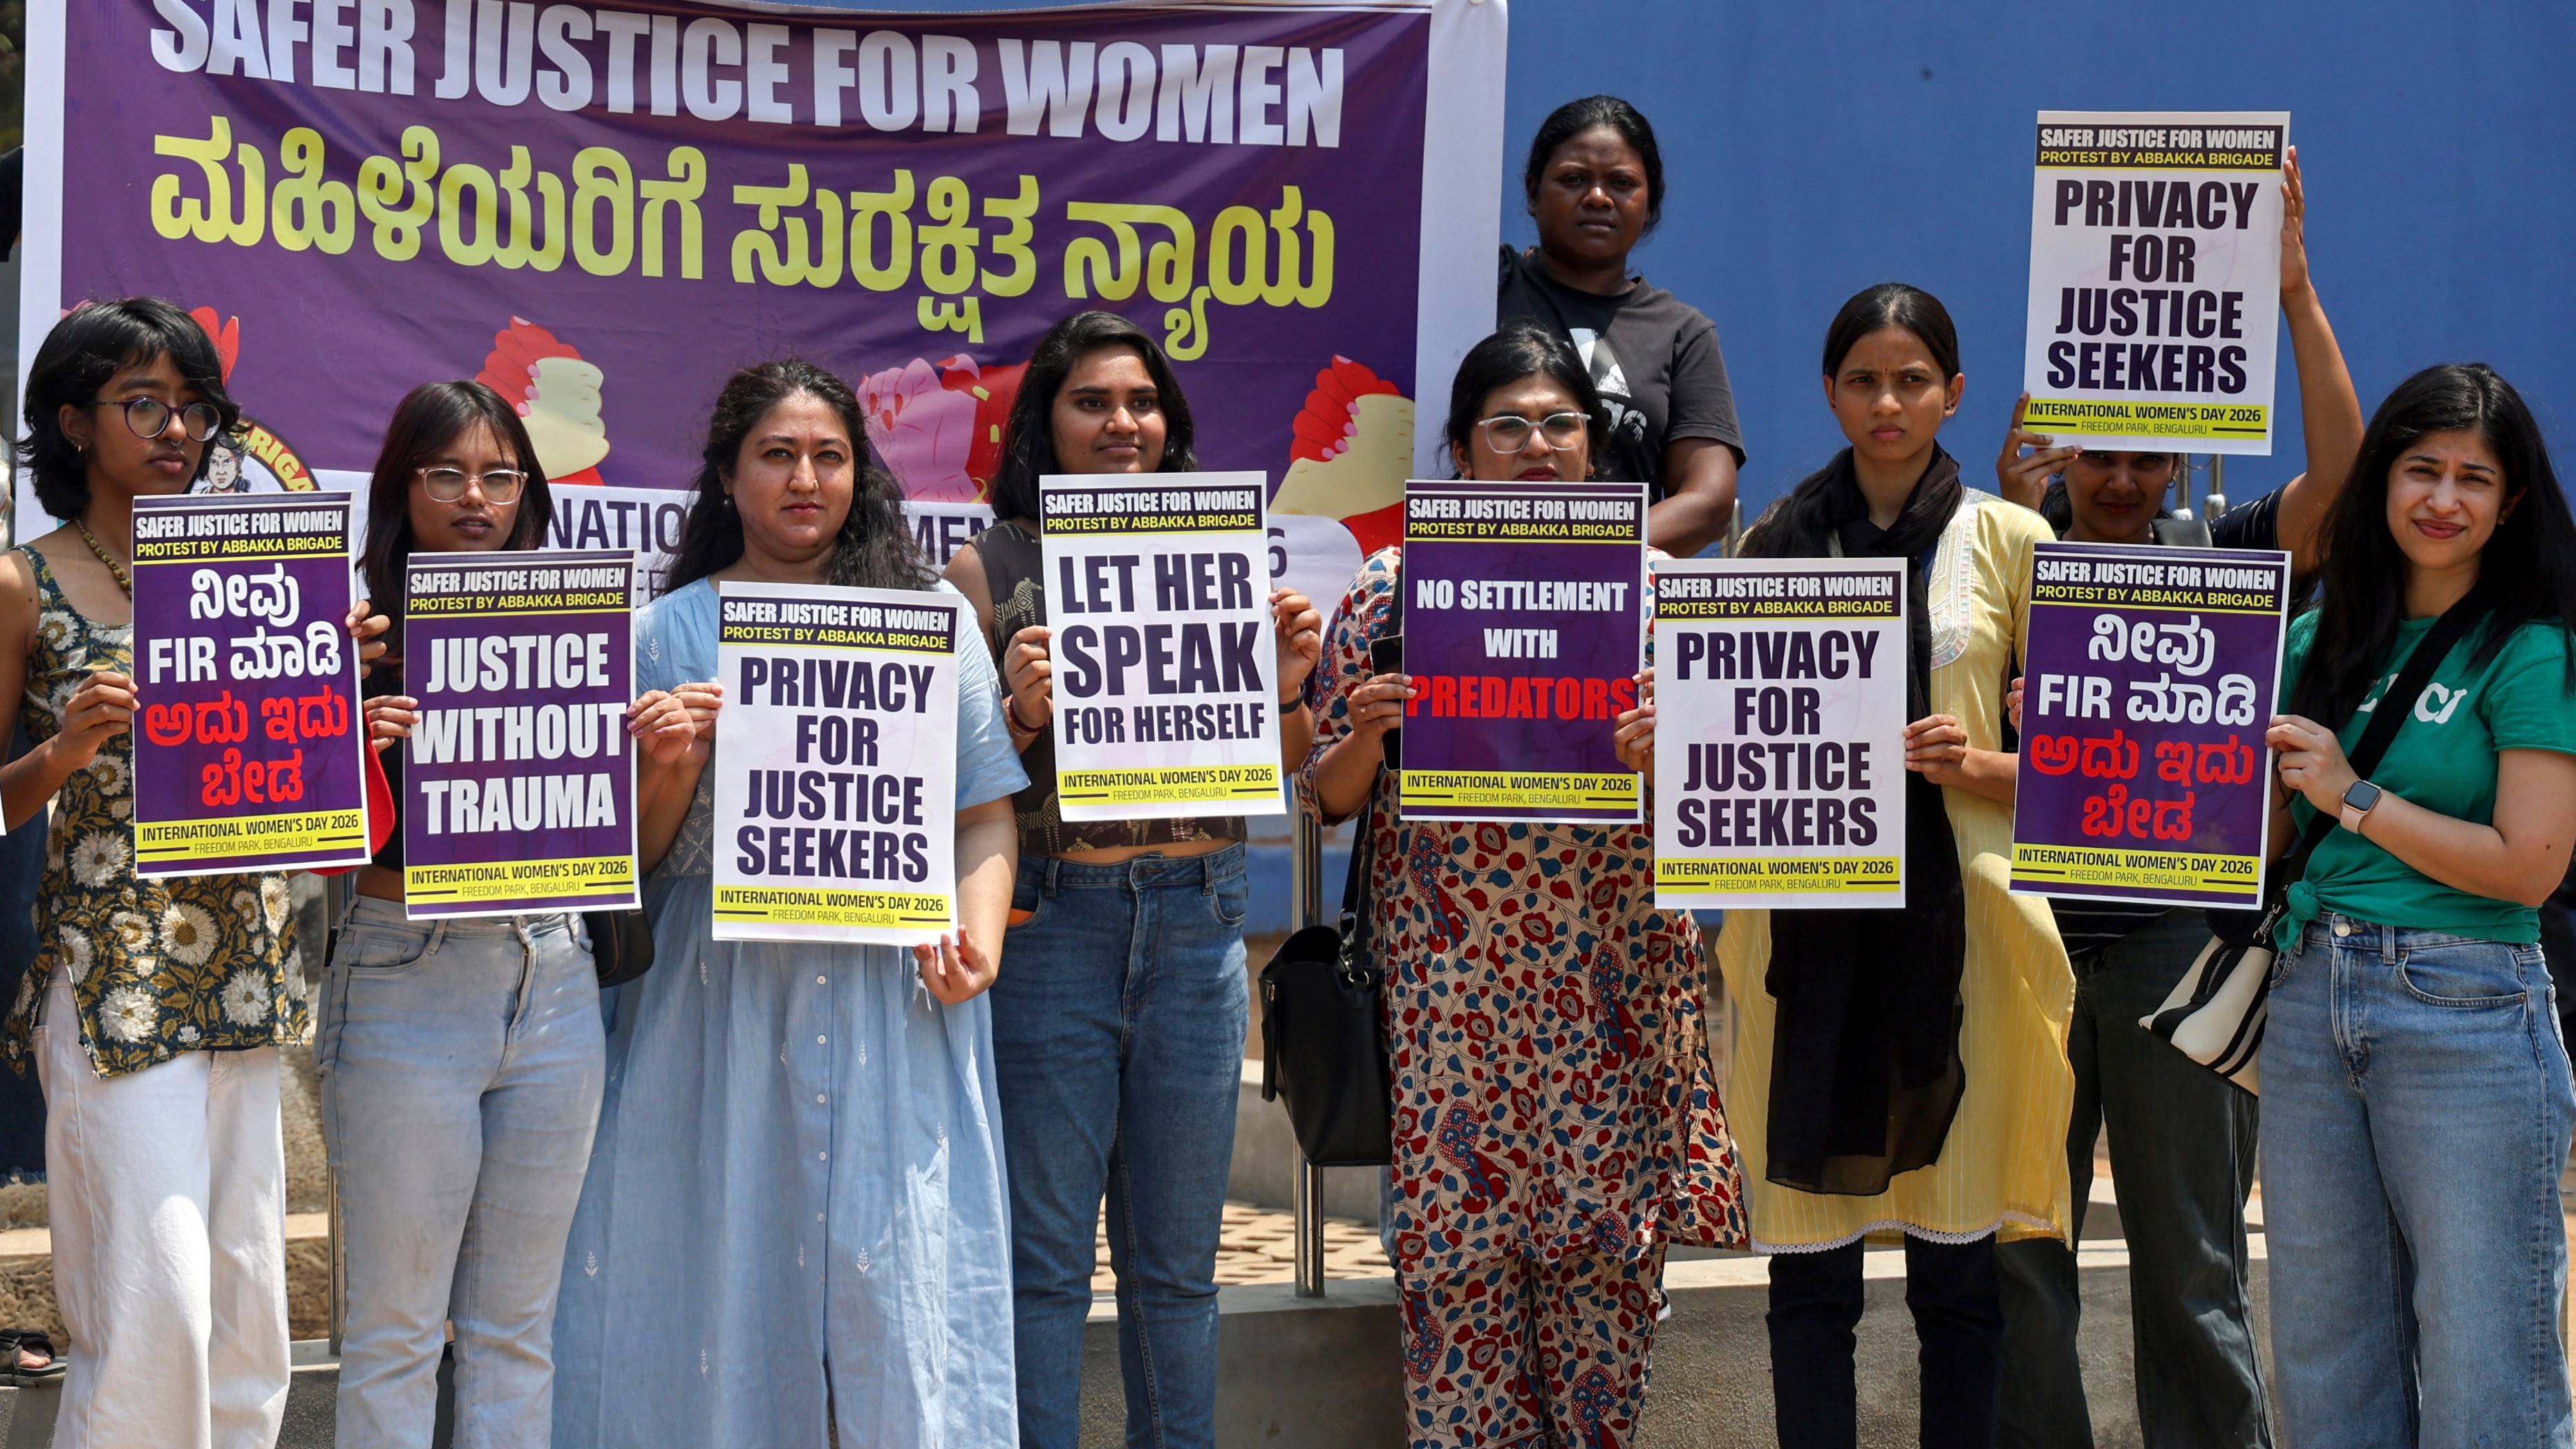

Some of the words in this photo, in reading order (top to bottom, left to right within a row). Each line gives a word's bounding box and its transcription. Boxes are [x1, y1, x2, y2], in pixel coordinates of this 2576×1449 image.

[151, 0, 415, 96] SAFER
[435, 0, 793, 125] JUSTICE
[814, 28, 979, 133] FOR
[997, 39, 1344, 148] WOMEN
[2041, 151, 2107, 162] PROTEST
[2111, 152, 2130, 163] BY
[2134, 153, 2205, 164] ABBAKKA
[2209, 153, 2273, 165] BRIGADE
[2042, 129, 2094, 147] SAFER
[2096, 129, 2166, 147] JUSTICE
[2170, 130, 2202, 148] FOR
[2206, 130, 2275, 149] WOMEN
[2055, 180, 2259, 230] PRIVACY
[151, 115, 706, 280] ಮಹಿಳೆಯರಿಗೆ
[731, 162, 1040, 344] ಸುರಕ್ಷಿತ
[1064, 185, 1334, 361] ನ್ಯಾಯ
[2109, 234, 2195, 283] FOR
[2056, 288, 2243, 338] JUSTICE
[2047, 341, 2246, 394] SEEKERS
[2031, 403, 2131, 418] INTERNATIONAL
[2136, 406, 2197, 420] WOMEN'S
[2201, 409, 2226, 420] DAY
[2229, 409, 2260, 422] 2026
[2082, 421, 2123, 431] FREEDOM
[2126, 423, 2150, 433] PARK,
[2154, 424, 2207, 434] BENGALURU
[1046, 494, 1093, 514] SAFER
[1097, 493, 1158, 512] JUSTICE
[1162, 492, 1191, 511] FOR
[1194, 491, 1254, 510] WOMEN
[1047, 518, 1107, 530] PROTEST
[1111, 517, 1128, 528] BY
[1131, 516, 1195, 528] ABBAKKA
[1198, 514, 1254, 527] BRIGADE
[1410, 499, 1460, 518] SAFER
[1463, 500, 1530, 518] JUSTICE
[1534, 501, 1565, 519] FOR
[1569, 501, 1635, 520] WOMEN
[137, 516, 184, 539] SAFER
[187, 514, 249, 536] JUSTICE
[252, 513, 280, 534] FOR
[283, 511, 342, 532] WOMEN
[1410, 523, 1474, 534] PROTEST
[1478, 523, 1496, 534] BY
[1501, 524, 1568, 535] ABBAKKA
[1572, 525, 1633, 536] BRIGADE
[138, 542, 198, 557] PROTEST
[201, 541, 218, 554] BY
[222, 539, 285, 553] ABBAKKA
[288, 536, 341, 550] BRIGADE
[190, 563, 299, 626] ನೀವು
[411, 572, 460, 593] SAFER
[462, 571, 527, 592] JUSTICE
[530, 570, 560, 590] FOR
[564, 568, 625, 588] WOMEN
[1060, 555, 1139, 613] LET
[1154, 553, 1252, 611] HER
[1417, 580, 1454, 609] NO
[1461, 580, 1628, 611] SETTLEMENT
[1659, 579, 1711, 598] SAFER
[1715, 578, 1784, 597] JUSTICE
[1788, 577, 1820, 597] FOR
[1824, 577, 1892, 596] WOMEN
[2038, 561, 2090, 581] SAFER
[2094, 563, 2164, 585] JUSTICE
[2168, 566, 2201, 586] FOR
[2206, 568, 2275, 590] WOMEN
[411, 597, 473, 610] PROTEST
[477, 597, 495, 608] BY
[498, 595, 563, 608] ABBAKKA
[566, 592, 623, 606] BRIGADE
[724, 602, 776, 622] SAFER
[780, 604, 847, 625] JUSTICE
[851, 607, 881, 627] FOR
[885, 609, 949, 631] WOMEN
[1660, 602, 1727, 614] PROTEST
[1731, 602, 1749, 613] BY
[1754, 601, 1825, 613] ABBAKKA
[1829, 601, 1892, 613] BRIGADE
[2036, 586, 2105, 599] PROTEST
[2108, 588, 2127, 600] BY
[2131, 590, 2203, 604] ABBAKKA
[2208, 592, 2273, 607] BRIGADE
[149, 637, 217, 683] FIR
[231, 621, 341, 680] ಮಾಡಿ
[724, 626, 791, 639] PROTEST
[795, 628, 814, 645] BY
[818, 630, 885, 644] ABBAKKA
[888, 633, 947, 648] BRIGADE
[1484, 628, 1557, 657] WITH
[1677, 630, 1879, 680] PRIVACY
[2089, 614, 2215, 675] ನೀವು
[427, 633, 609, 692] JUSTICE
[1062, 621, 1263, 698] SPEAK
[740, 657, 934, 713] PRIVACY
[1407, 675, 1635, 720] PREDATORS
[2038, 674, 2112, 718] FIR
[2127, 671, 2255, 725] ಮಾಡಿ
[145, 691, 248, 746] ಅದು
[261, 685, 348, 742] ಇದು
[1064, 707, 1125, 744] FOR
[1134, 703, 1264, 742] HERSELF
[1735, 686, 1820, 736] FOR
[410, 703, 627, 764] WITHOUT
[796, 715, 878, 766] FOR
[202, 748, 303, 806] ಬೇಡ
[1684, 742, 1870, 792] JUSTICE
[2031, 729, 2139, 778] ಅದು
[2156, 736, 2254, 785] ಇದು
[744, 770, 923, 825] JUSTICE
[1064, 773, 1157, 787] INTERNATIONAL
[1160, 770, 1216, 784] WOMEN'S
[1219, 770, 1241, 782] DAY
[1245, 769, 1272, 781] 2026
[1408, 776, 1506, 788] INTERNATIONAL
[1511, 777, 1570, 789] WOMEN'S
[1574, 778, 1598, 790] DAY
[1601, 778, 1631, 791] 2026
[421, 774, 616, 834] TRAUMA
[1677, 797, 1877, 848] SEEKERS
[2082, 784, 2194, 841] ಬೇಡ
[143, 823, 243, 841] INTERNATIONAL
[246, 819, 302, 834] WOMEN'S
[306, 817, 328, 830] DAY
[332, 814, 358, 829] 2026
[412, 867, 508, 884] INTERNATIONAL
[512, 864, 569, 879] WOMEN'S
[573, 862, 595, 876] DAY
[599, 861, 628, 875] 2026
[737, 825, 928, 882] SEEKERS
[1663, 863, 1764, 875] INTERNATIONAL
[1768, 861, 1830, 874] WOMEN'S
[1834, 861, 1859, 874] DAY
[1862, 861, 1893, 873] 2026
[2019, 849, 2121, 866] INTERNATIONAL
[2126, 855, 2187, 870] WOMEN'S
[2192, 859, 2217, 872] DAY
[2220, 860, 2252, 874] 2026
[721, 890, 822, 906] INTERNATIONAL
[827, 894, 885, 908] WOMEN'S
[889, 897, 910, 909] DAY
[914, 898, 943, 911] 2026
[1715, 879, 1756, 889] FREEDOM
[1760, 879, 1784, 889] PARK,
[1787, 879, 1840, 888] BENGALURU
